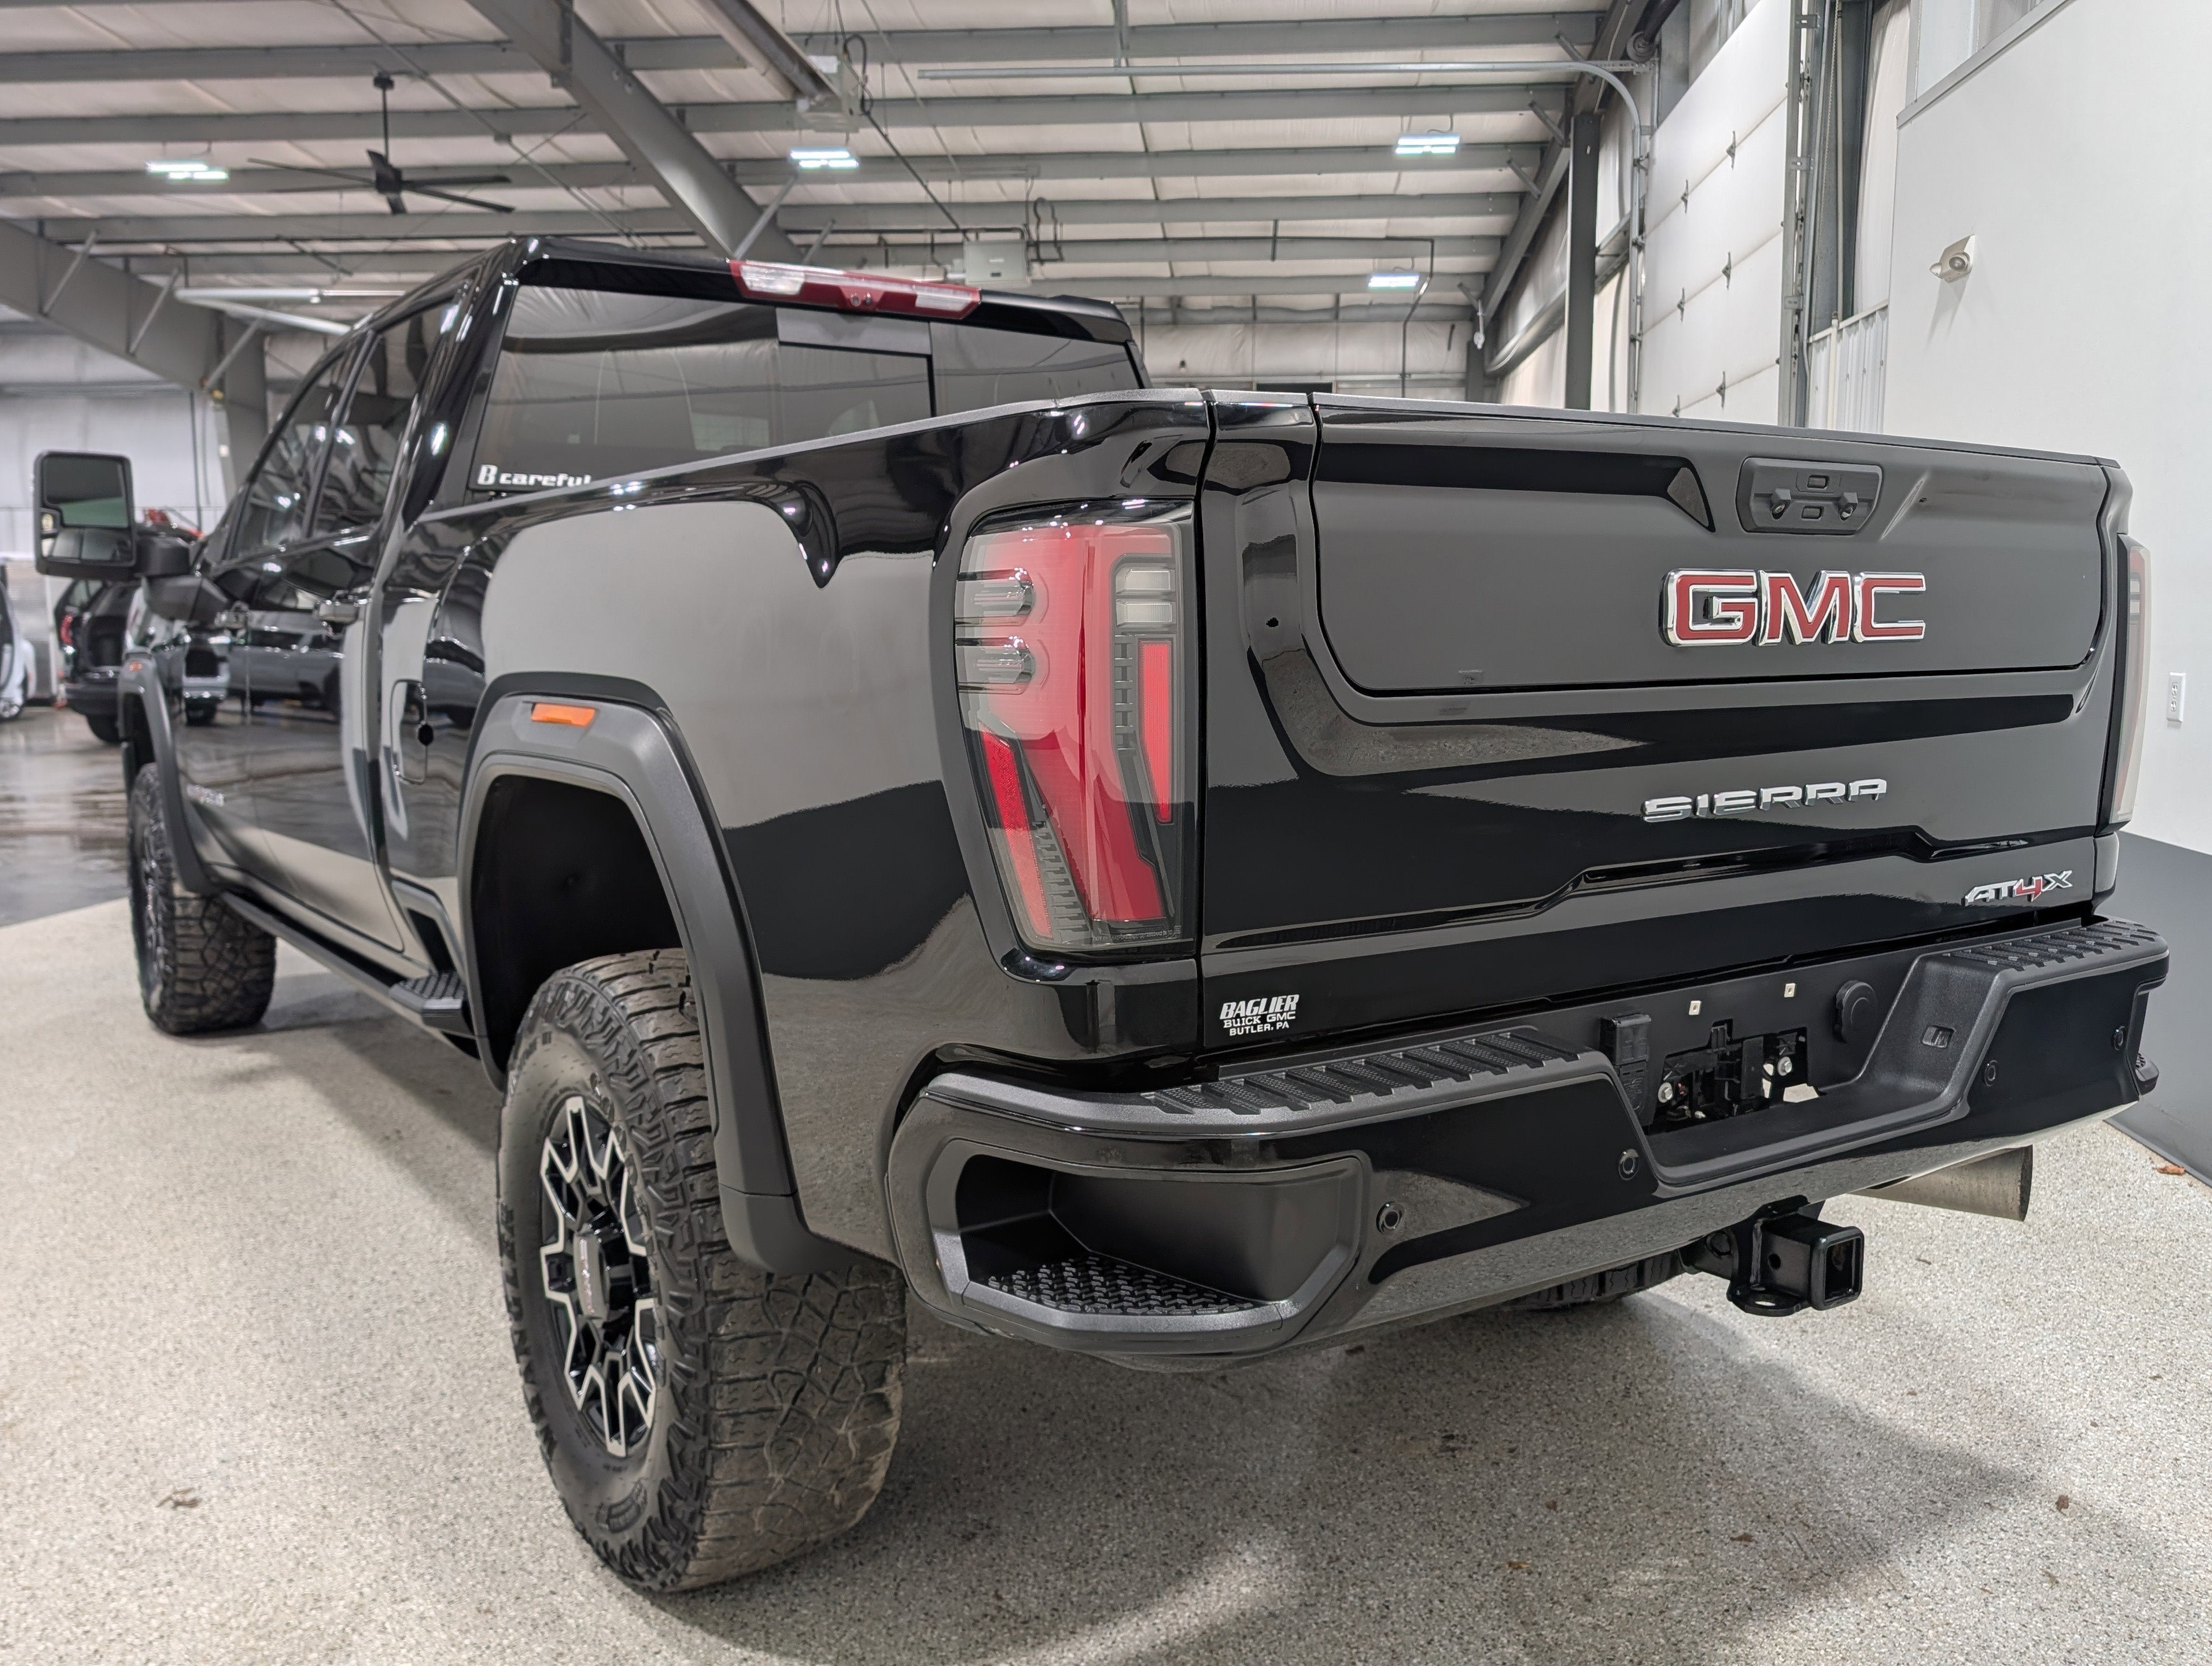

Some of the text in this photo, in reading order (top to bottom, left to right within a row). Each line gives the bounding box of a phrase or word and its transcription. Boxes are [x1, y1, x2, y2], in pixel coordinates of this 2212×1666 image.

[1659, 568, 1927, 647] GMC
[1641, 778, 1887, 823] SIERRA
[1961, 870, 2073, 907] AT4X
[1220, 994, 1300, 1020] BAGLIER
[1223, 1011, 1296, 1028] BUICK GMC
[1229, 1021, 1289, 1036] BUTLER, PA
